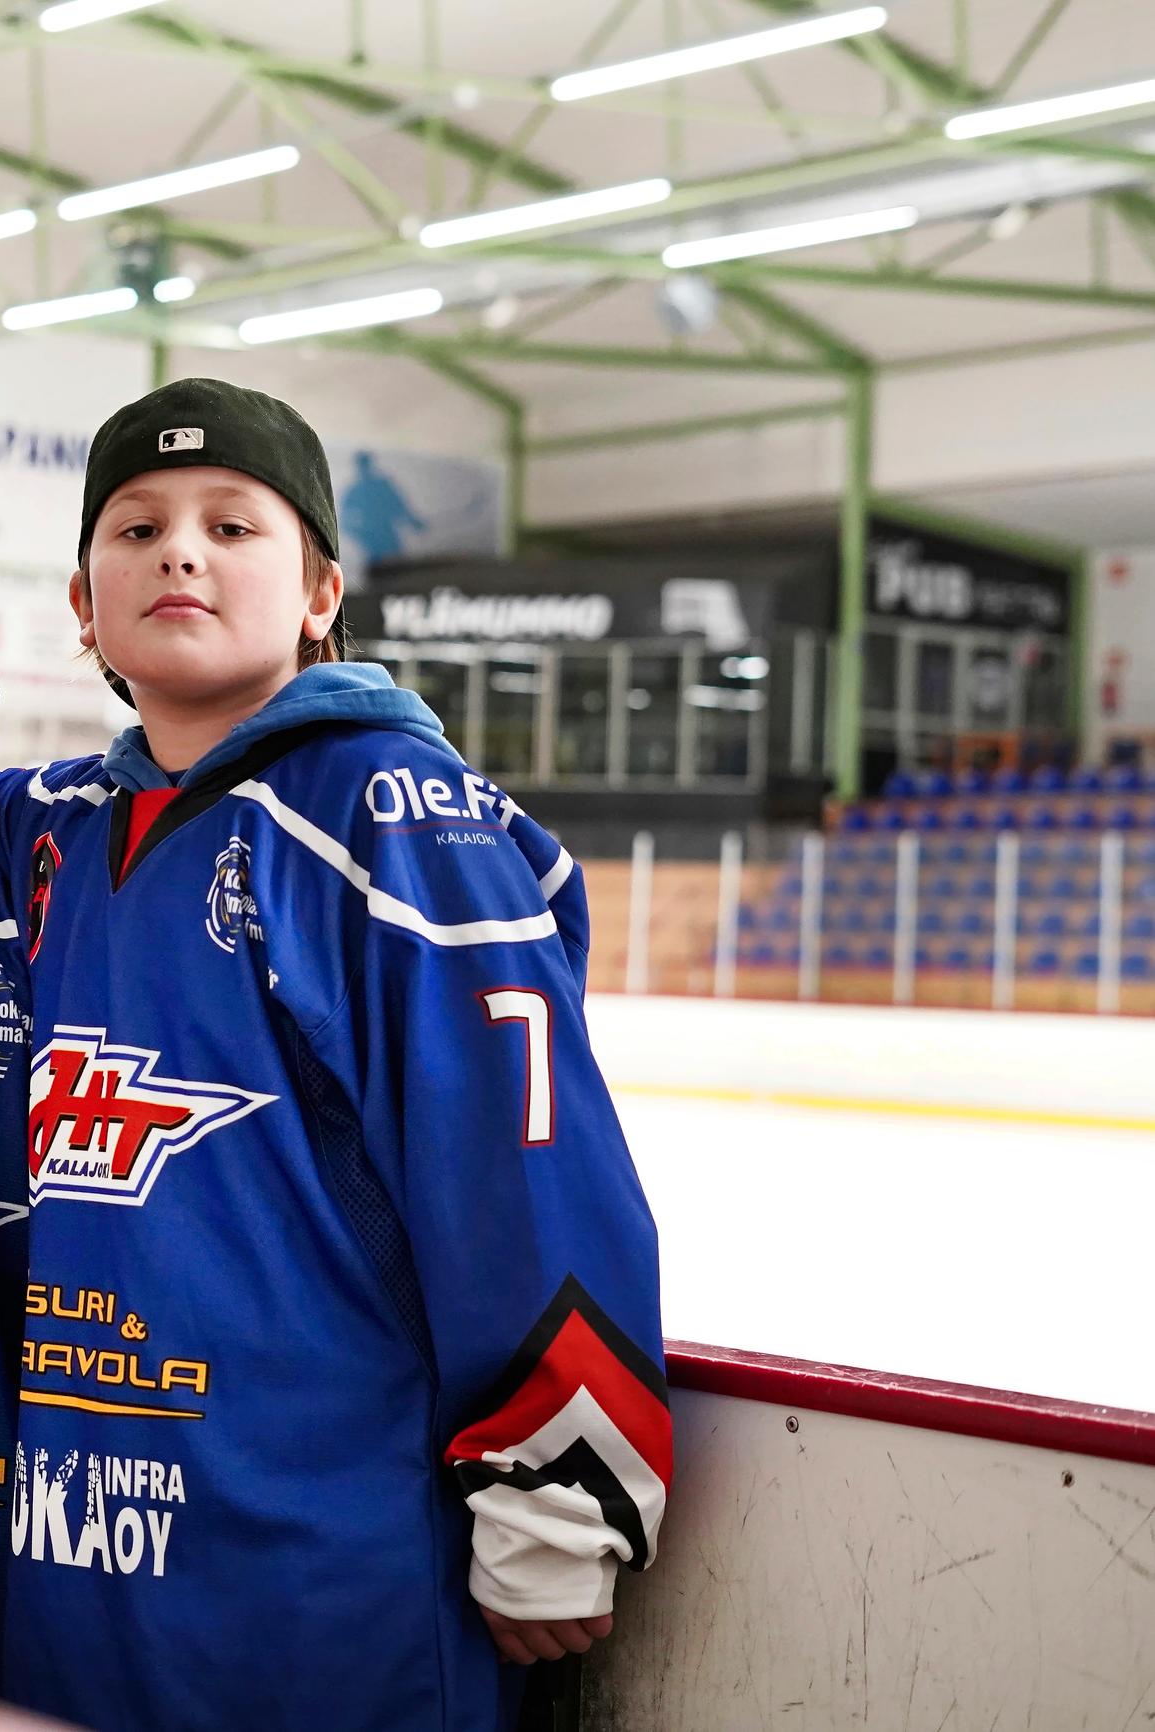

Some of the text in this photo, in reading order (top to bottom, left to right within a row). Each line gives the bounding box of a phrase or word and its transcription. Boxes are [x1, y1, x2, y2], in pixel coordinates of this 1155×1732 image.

[475, 986, 554, 1148] 7
[46, 1158, 110, 1179] KALAJOKI
[121, 1312, 148, 1340] &
[105, 1455, 187, 1504] INFRA
[113, 1505, 174, 1577] OY
